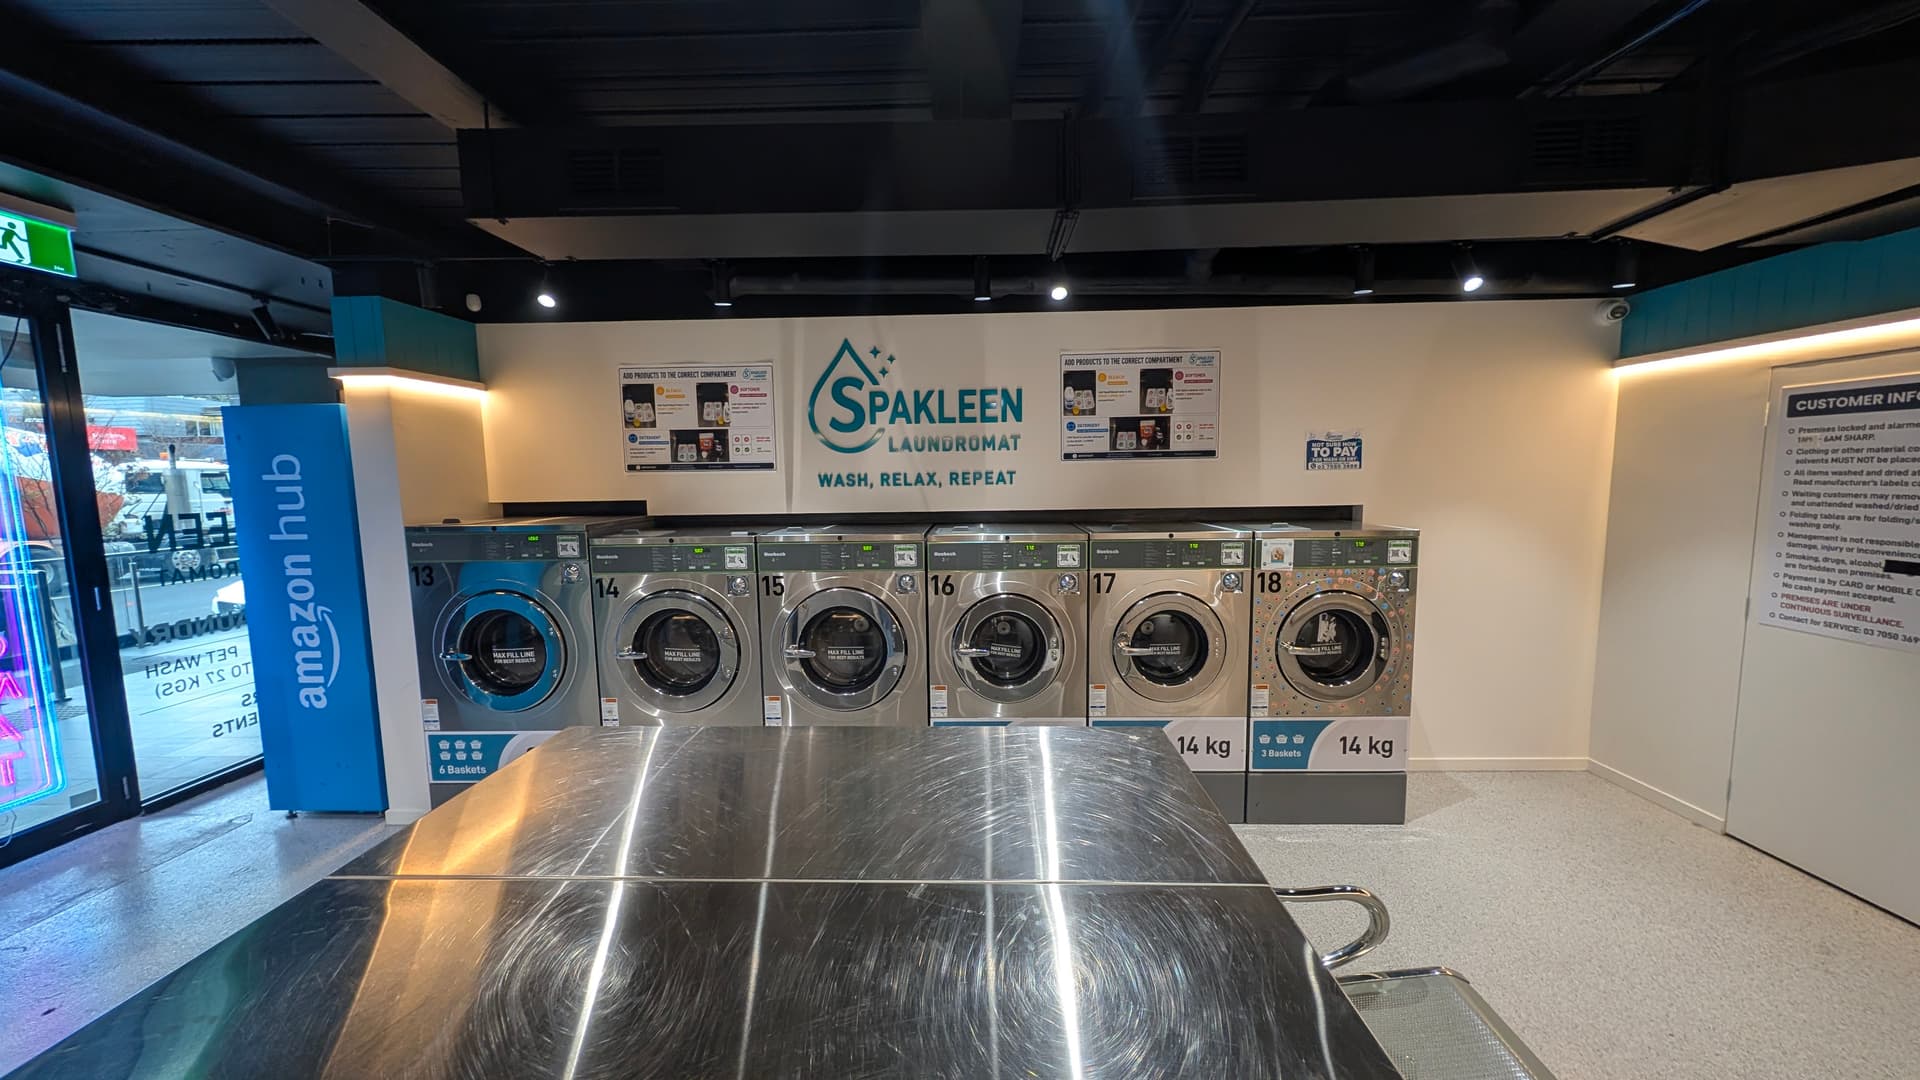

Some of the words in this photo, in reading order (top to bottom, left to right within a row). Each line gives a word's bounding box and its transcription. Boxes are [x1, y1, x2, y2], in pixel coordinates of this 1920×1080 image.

[1103, 357, 1110, 365] TO
[1145, 356, 1183, 364] COMPARTMENT
[700, 370, 737, 378] COMPARTMENT
[829, 376, 1023, 433] SPAKLEEN
[1796, 394, 1884, 411] CUSTOMER
[1798, 426, 1835, 434] Premises
[1838, 424, 1866, 432] locked
[888, 434, 1021, 453] LAUNDROMAT
[1866, 445, 1905, 453] material
[1311, 447, 1330, 457] TO
[1333, 446, 1358, 457] PAY
[818, 472, 874, 489] WASH,
[880, 472, 942, 488] RELAX,
[950, 470, 1016, 486] REPEAT
[1885, 469, 1909, 477] dried
[1880, 479, 1909, 487] labels
[261, 454, 308, 540] hub
[1792, 490, 1820, 499] Waiting
[1823, 491, 1868, 499] customers
[1807, 501, 1853, 509] unattended
[1855, 502, 1919, 511] washed/dried
[1790, 511, 1818, 520] Folding
[1863, 514, 1876, 522] for
[1789, 521, 1821, 530] washing
[1787, 532, 1839, 542] Management
[1821, 544, 1844, 553] injury
[1798, 563, 1836, 573] forbidden
[411, 566, 434, 587] 13
[1092, 572, 1116, 594] 17
[1257, 572, 1282, 593] 18
[595, 577, 619, 599] 14
[761, 575, 785, 596] 15
[930, 574, 955, 596] 16
[1783, 573, 1817, 583] Payment
[1827, 578, 1837, 587] by
[1839, 580, 1864, 589] CARD
[1877, 584, 1913, 595] MOBILE
[1794, 584, 1813, 592] cash
[1814, 587, 1850, 597] payment
[1780, 602, 1832, 616] CONTINUOUS
[1781, 593, 1820, 605] PREMISES
[1822, 598, 1840, 608] ARE
[1841, 602, 1871, 612] UNDER
[283, 554, 328, 710] amazon
[1779, 613, 1808, 624] Contact
[1810, 618, 1821, 626] for
[1863, 628, 1875, 636] 03
[1877, 630, 1899, 640] 7050
[1177, 736, 1199, 755] 14
[1206, 735, 1231, 758] kg
[1261, 749, 1267, 757] 3
[1268, 749, 1301, 758] Baskets
[1339, 736, 1362, 755] 14
[1368, 736, 1394, 758] kg
[439, 765, 446, 774] 6
[447, 765, 487, 774] Baskets
